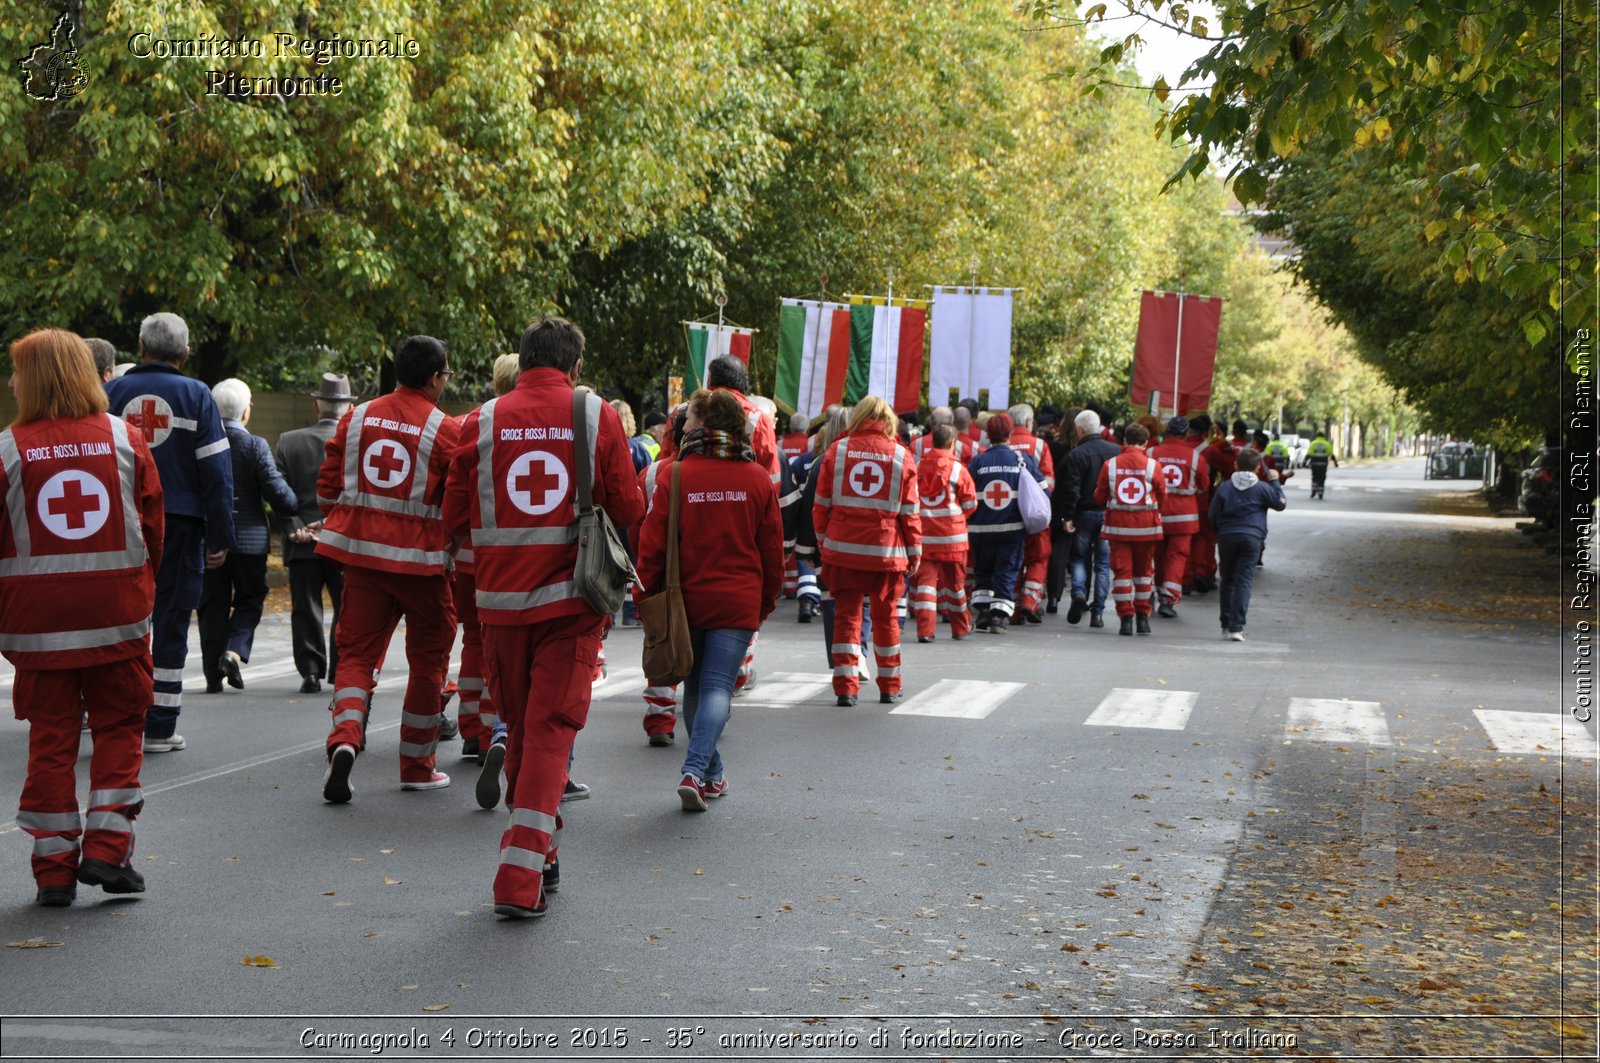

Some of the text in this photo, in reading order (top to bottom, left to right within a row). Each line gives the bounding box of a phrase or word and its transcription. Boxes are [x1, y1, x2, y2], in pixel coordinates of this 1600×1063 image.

[501, 428, 523, 440] CROCE
[525, 428, 546, 440] ROSSA
[26, 442, 111, 462] CROCE ROSSA ITALIANA
[687, 491, 747, 503] CROCE ROSSA ITALIANA
